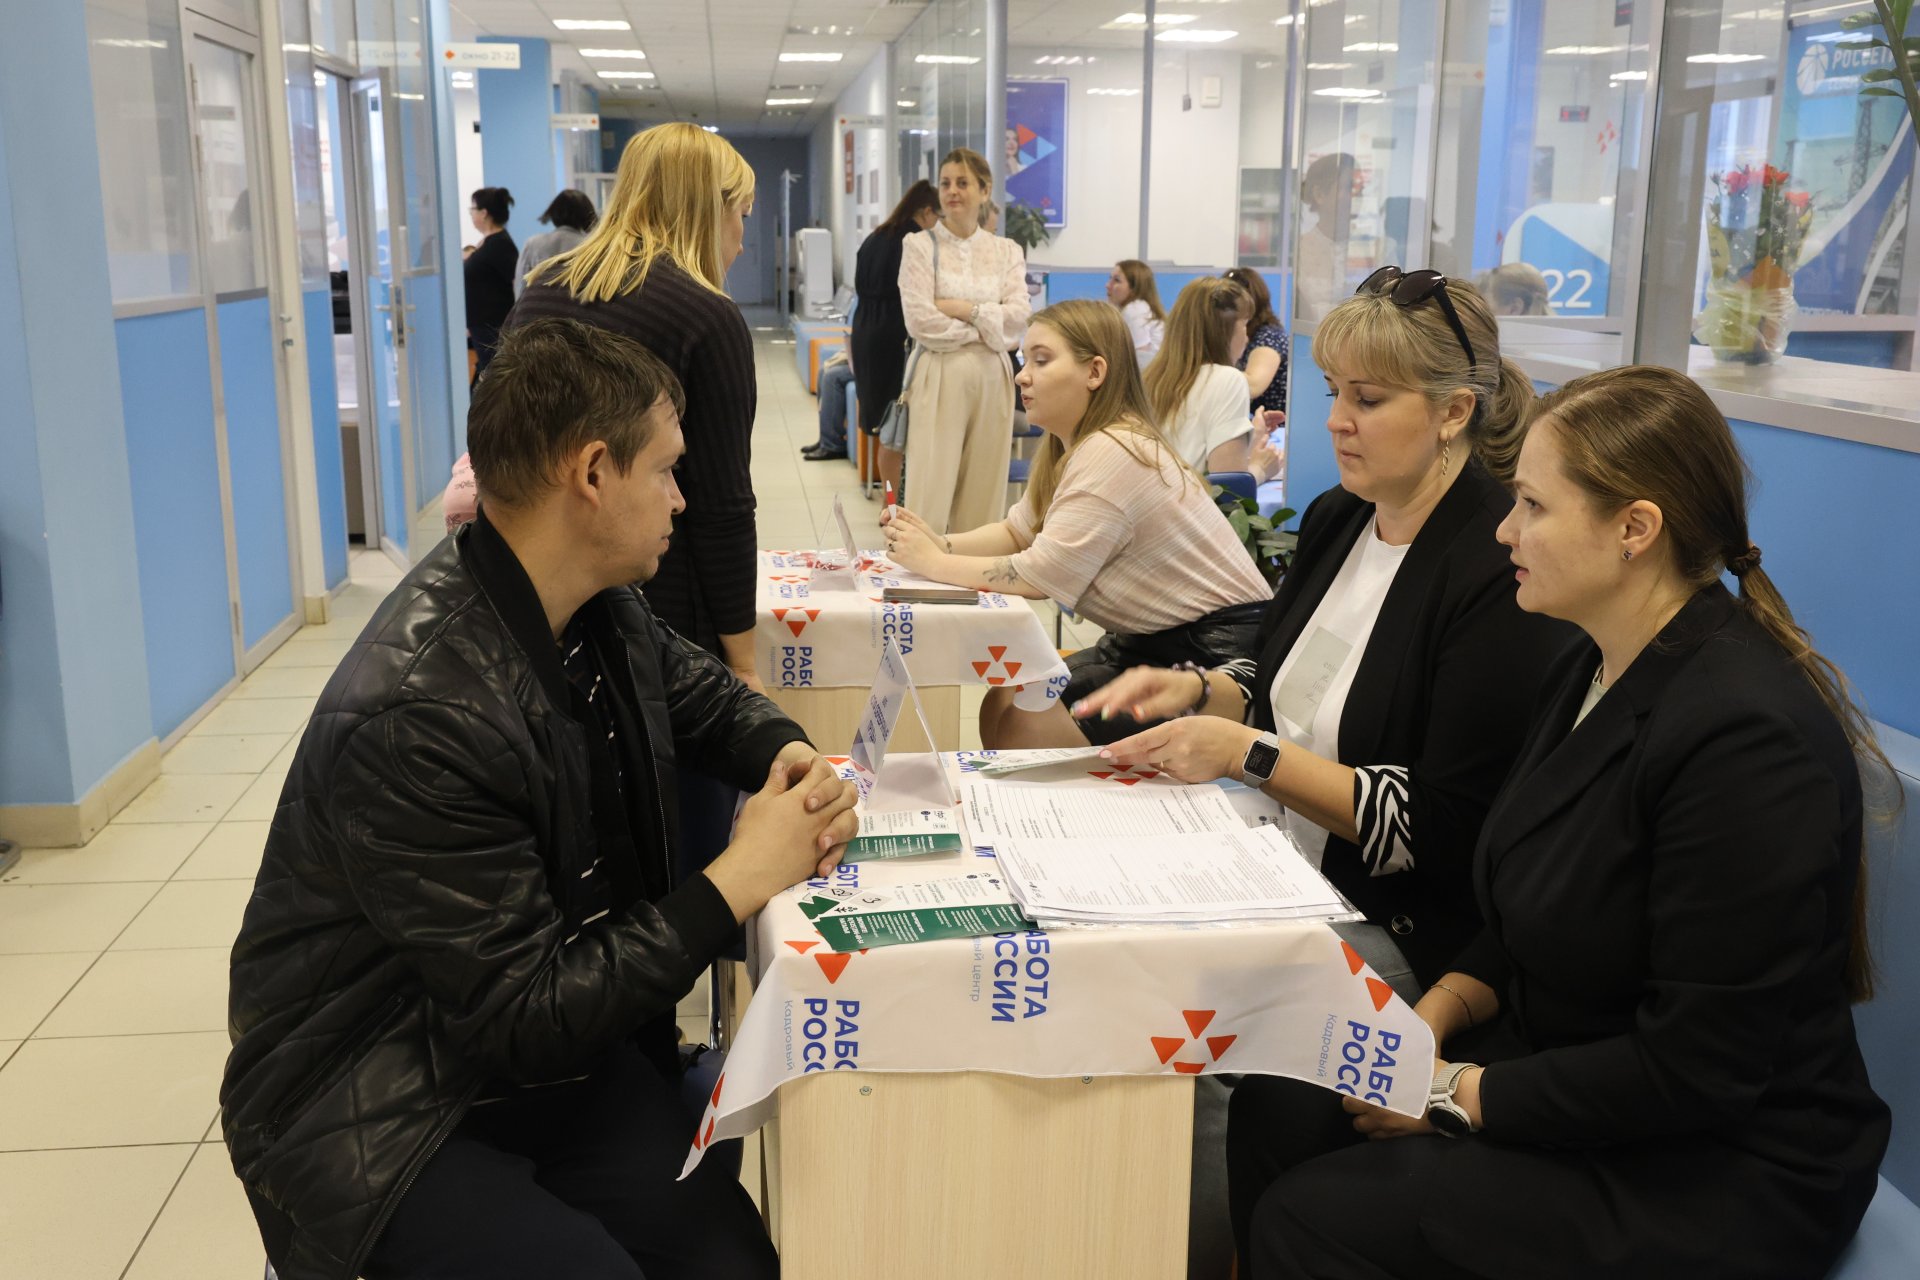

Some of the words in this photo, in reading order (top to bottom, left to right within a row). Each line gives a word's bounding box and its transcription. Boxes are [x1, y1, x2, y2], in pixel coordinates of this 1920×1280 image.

[1541, 269, 1592, 308] 22
[899, 604, 914, 656] АБОТА
[969, 964, 981, 1003] центр
[992, 932, 1018, 1022] ОССИИ
[1023, 929, 1050, 1018] АБОТА
[784, 1000, 797, 1071] Кадровый
[1316, 1013, 1338, 1078] Кадровый
